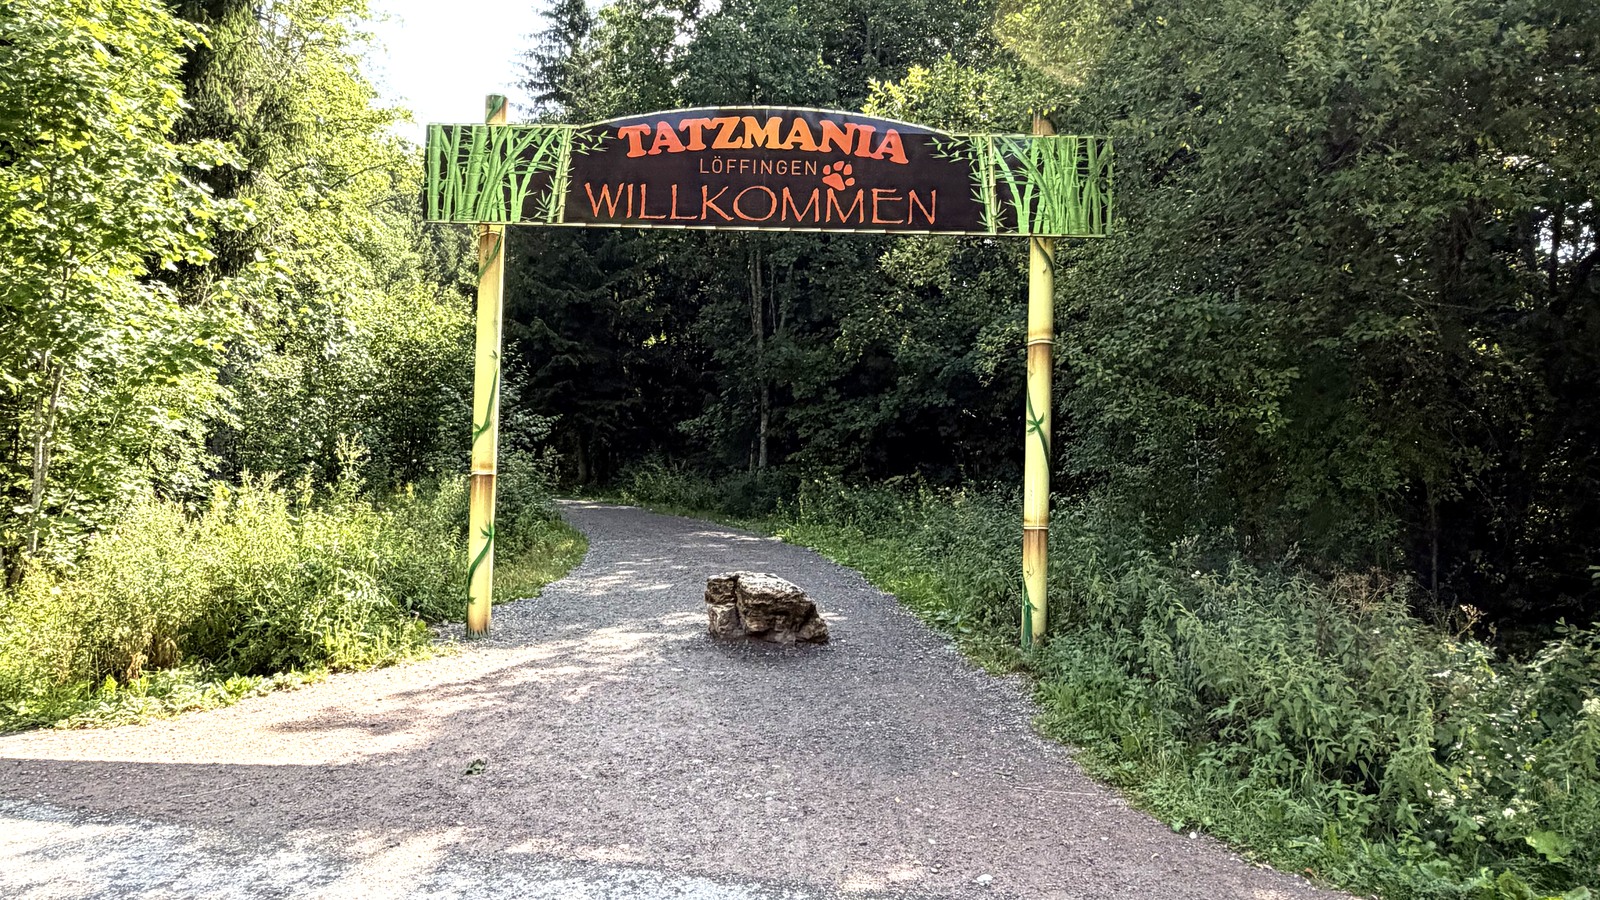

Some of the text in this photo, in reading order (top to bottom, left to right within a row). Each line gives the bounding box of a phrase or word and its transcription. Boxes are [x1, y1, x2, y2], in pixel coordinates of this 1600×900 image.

[617, 116, 909, 164] TATZMANIA
[699, 155, 817, 175] LÖFFINGEN
[584, 182, 937, 225] WILLKOMMEN
